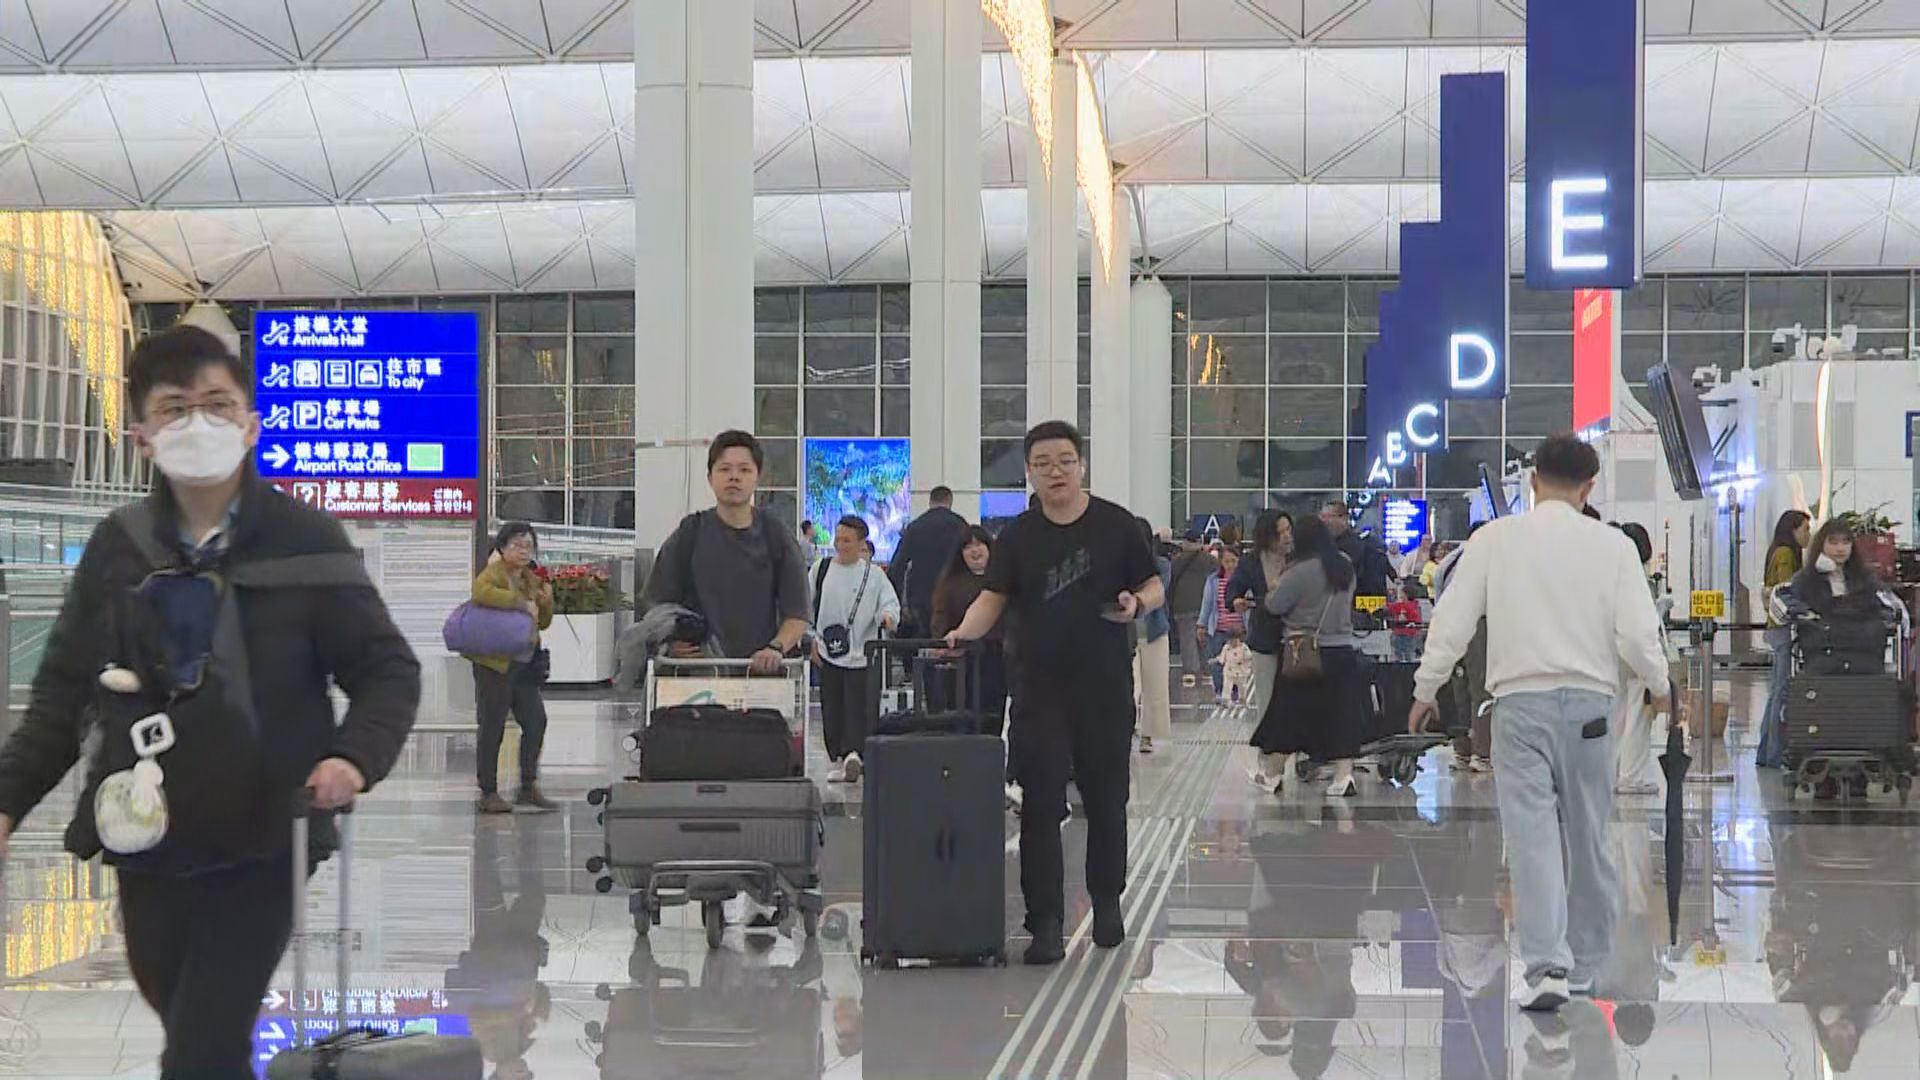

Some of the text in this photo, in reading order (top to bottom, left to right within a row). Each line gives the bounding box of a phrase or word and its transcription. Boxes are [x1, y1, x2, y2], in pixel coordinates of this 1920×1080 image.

[1550, 177, 1608, 270] E
[293, 333, 364, 346] Arrivals Hall
[1450, 333, 1496, 390] D
[385, 375, 424, 391] To city
[325, 398, 380, 417] 停車場
[324, 416, 380, 430] Car Parks
[1405, 403, 1439, 446] C
[294, 459, 402, 475] Airport Post Office
[1367, 456, 1392, 484] A
[324, 498, 430, 512] Customer Services
[1204, 514, 1220, 535] A
[1692, 593, 1715, 605] 出口
[1696, 606, 1712, 615] Out
